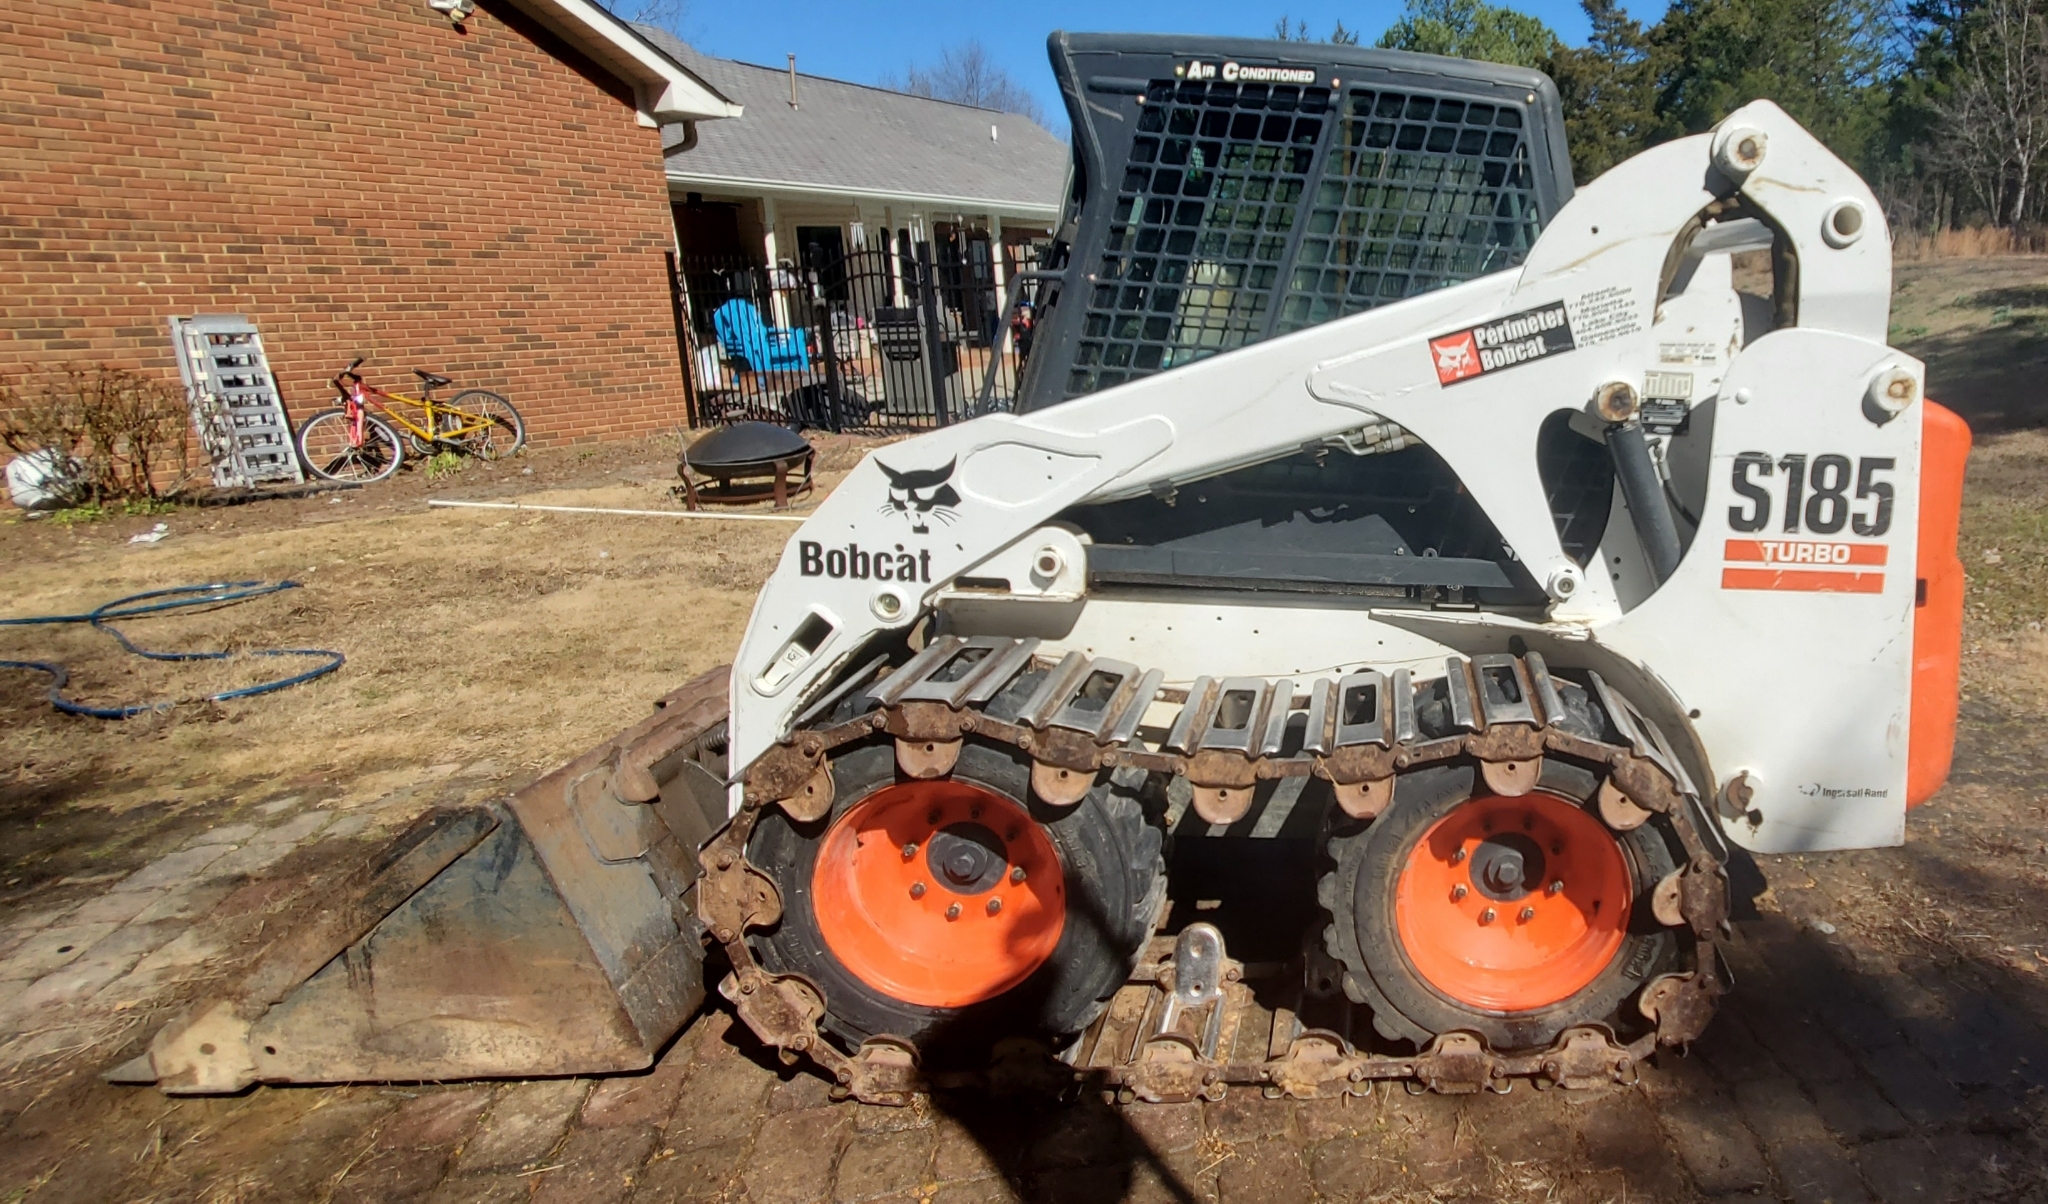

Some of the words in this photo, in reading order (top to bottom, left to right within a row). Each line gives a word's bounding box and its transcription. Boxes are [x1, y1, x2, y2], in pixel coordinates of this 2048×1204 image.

[1187, 60, 1216, 80] AIR
[1222, 61, 1316, 84] CONDITIONED
[1473, 306, 1566, 350] Perimeter
[1480, 335, 1547, 372] Bobcat
[1728, 451, 1897, 537] S185
[799, 540, 932, 584] Bobcat
[1762, 541, 1851, 564] TURBO
